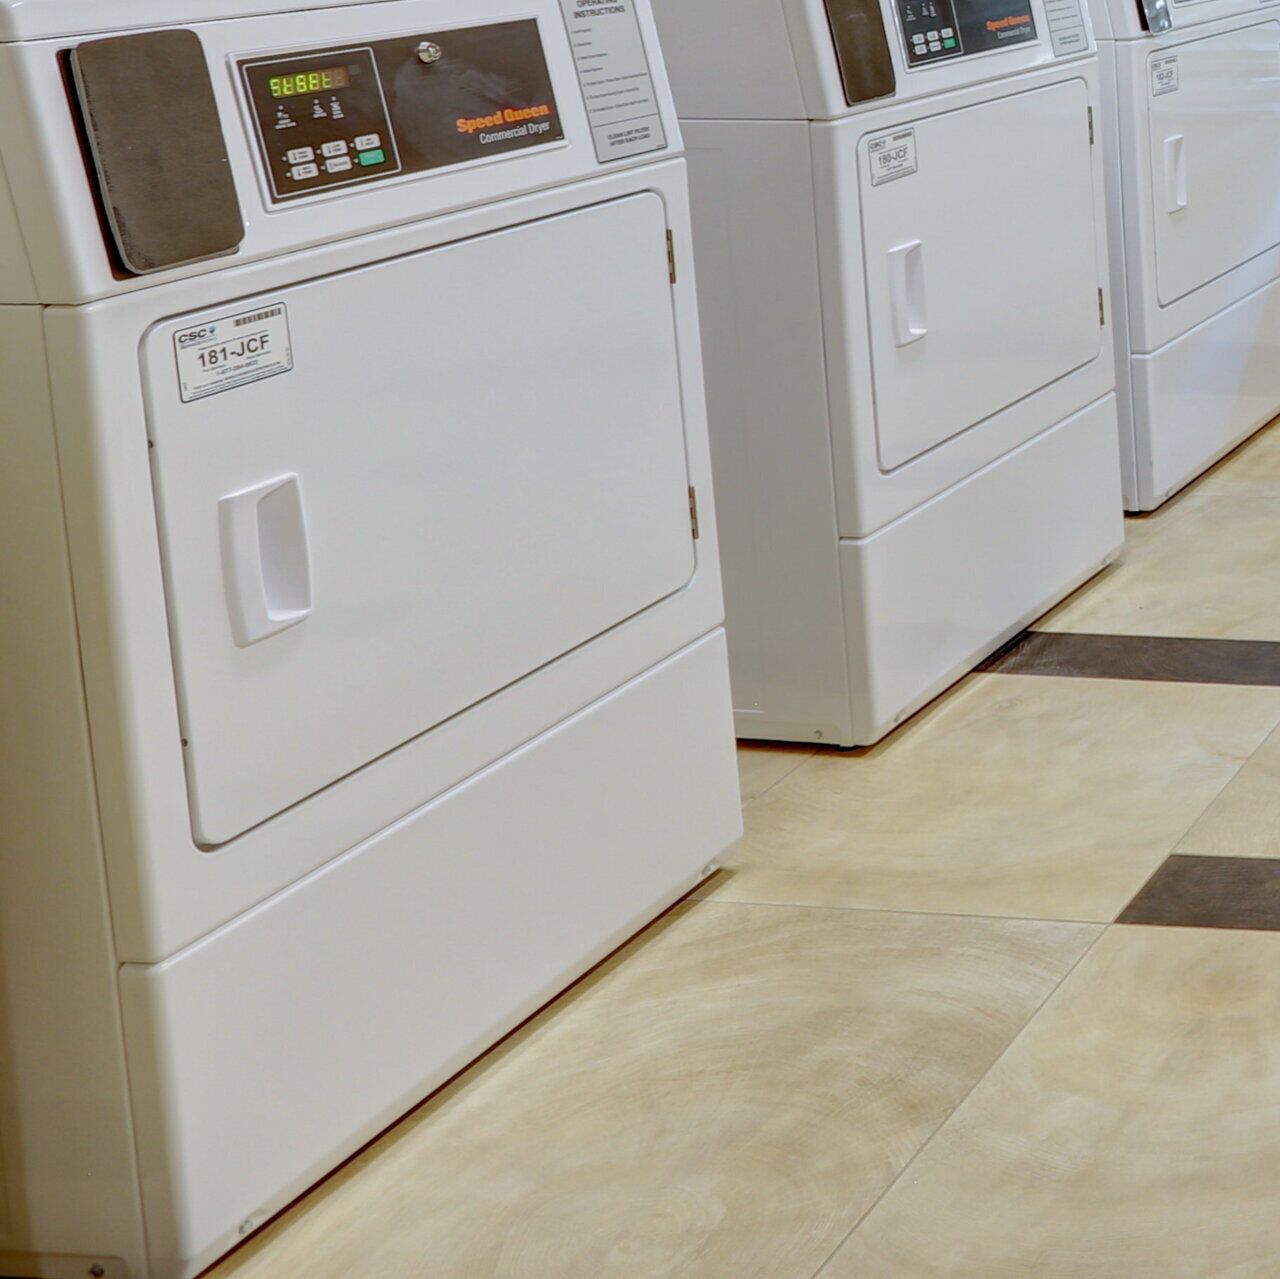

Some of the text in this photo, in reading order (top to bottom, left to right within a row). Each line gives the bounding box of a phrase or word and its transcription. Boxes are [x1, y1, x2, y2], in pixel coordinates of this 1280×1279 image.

[573, 4, 625, 19] INSTRUCTIONS
[456, 105, 550, 133] Speed Queen
[480, 122, 550, 144] Commercial Dryer
[178, 328, 207, 344] CSC
[197, 333, 270, 368] 181-JCF
